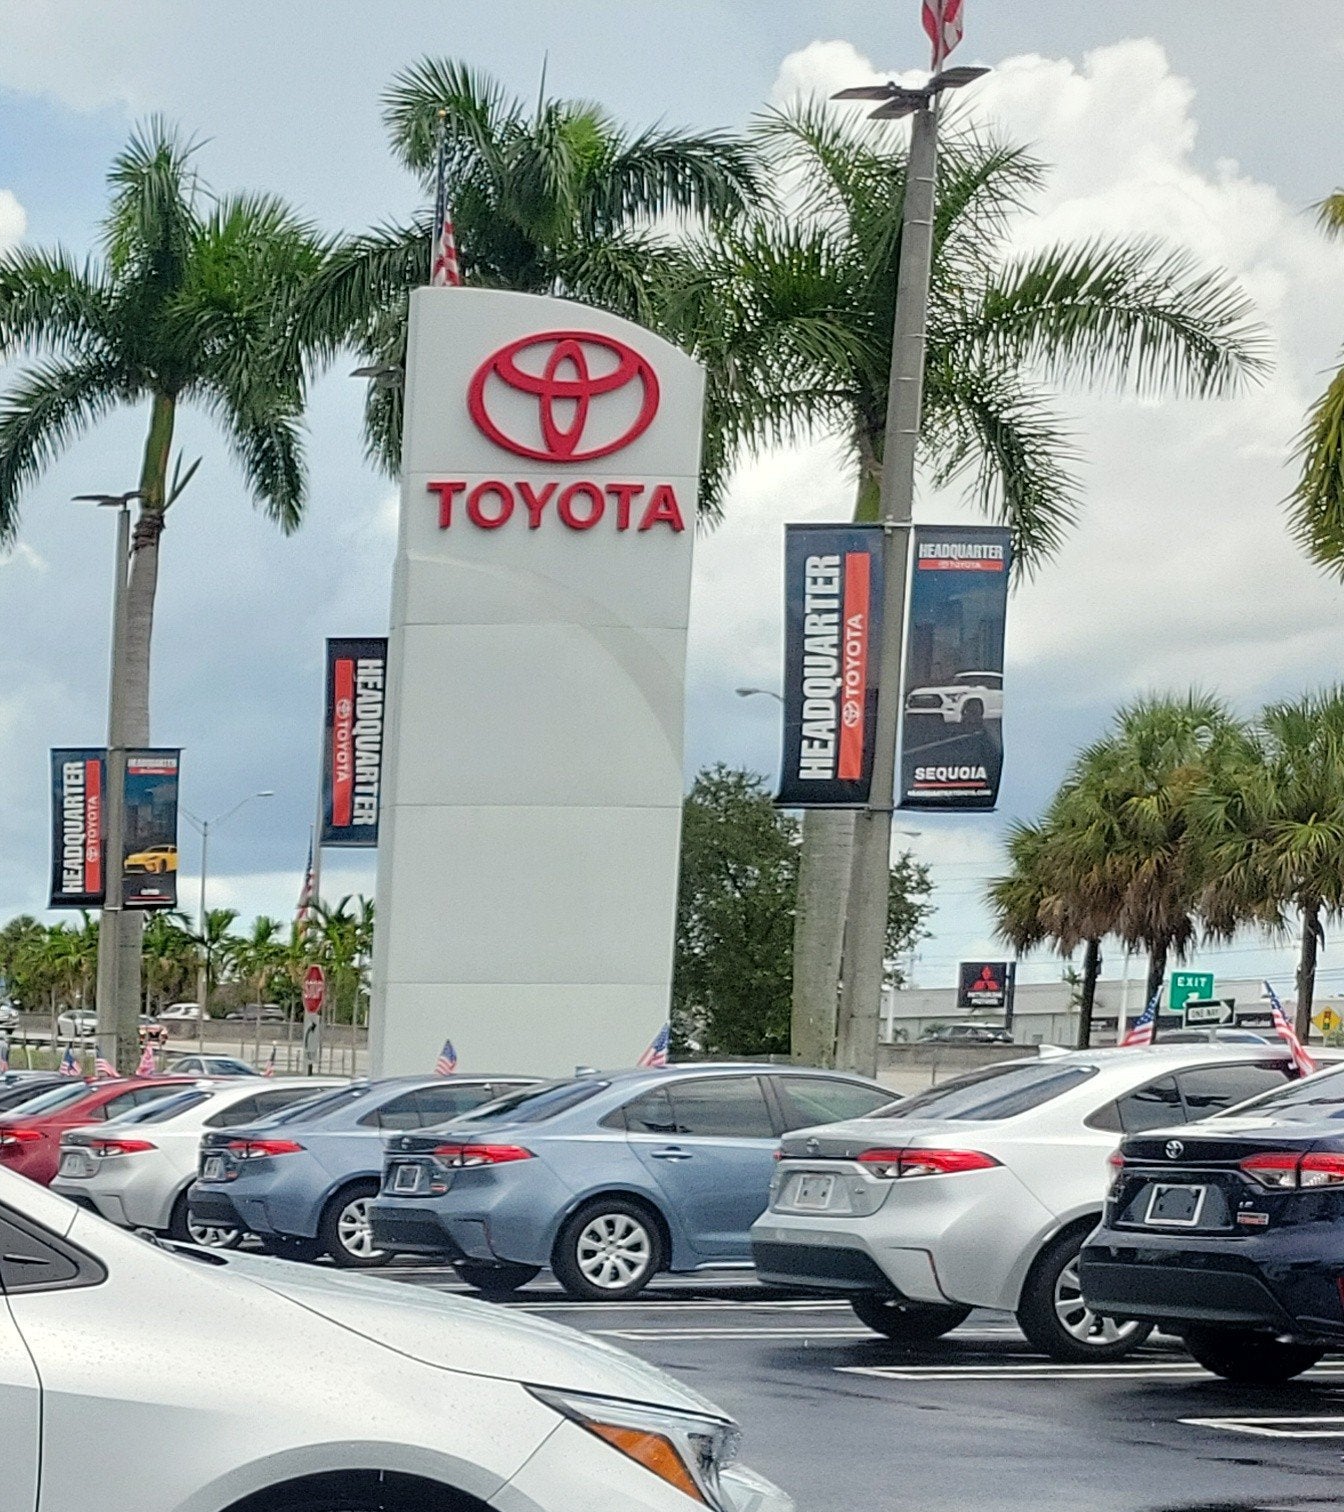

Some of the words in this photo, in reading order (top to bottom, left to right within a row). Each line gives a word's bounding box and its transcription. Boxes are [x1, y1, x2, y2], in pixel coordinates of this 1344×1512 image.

[427, 481, 685, 533] TOYOTA
[919, 543, 1003, 560] HEADQUARTER
[799, 555, 843, 780] HEADQUARTER
[844, 613, 864, 698] TOYOTA
[336, 723, 350, 783] TOYOTA
[352, 659, 384, 826] HEADQUARTER
[914, 766, 987, 782] SEQUOIA
[62, 761, 86, 893] HEADQUARTER
[87, 795, 99, 848] TOYOTA
[1177, 976, 1207, 987] EXIT
